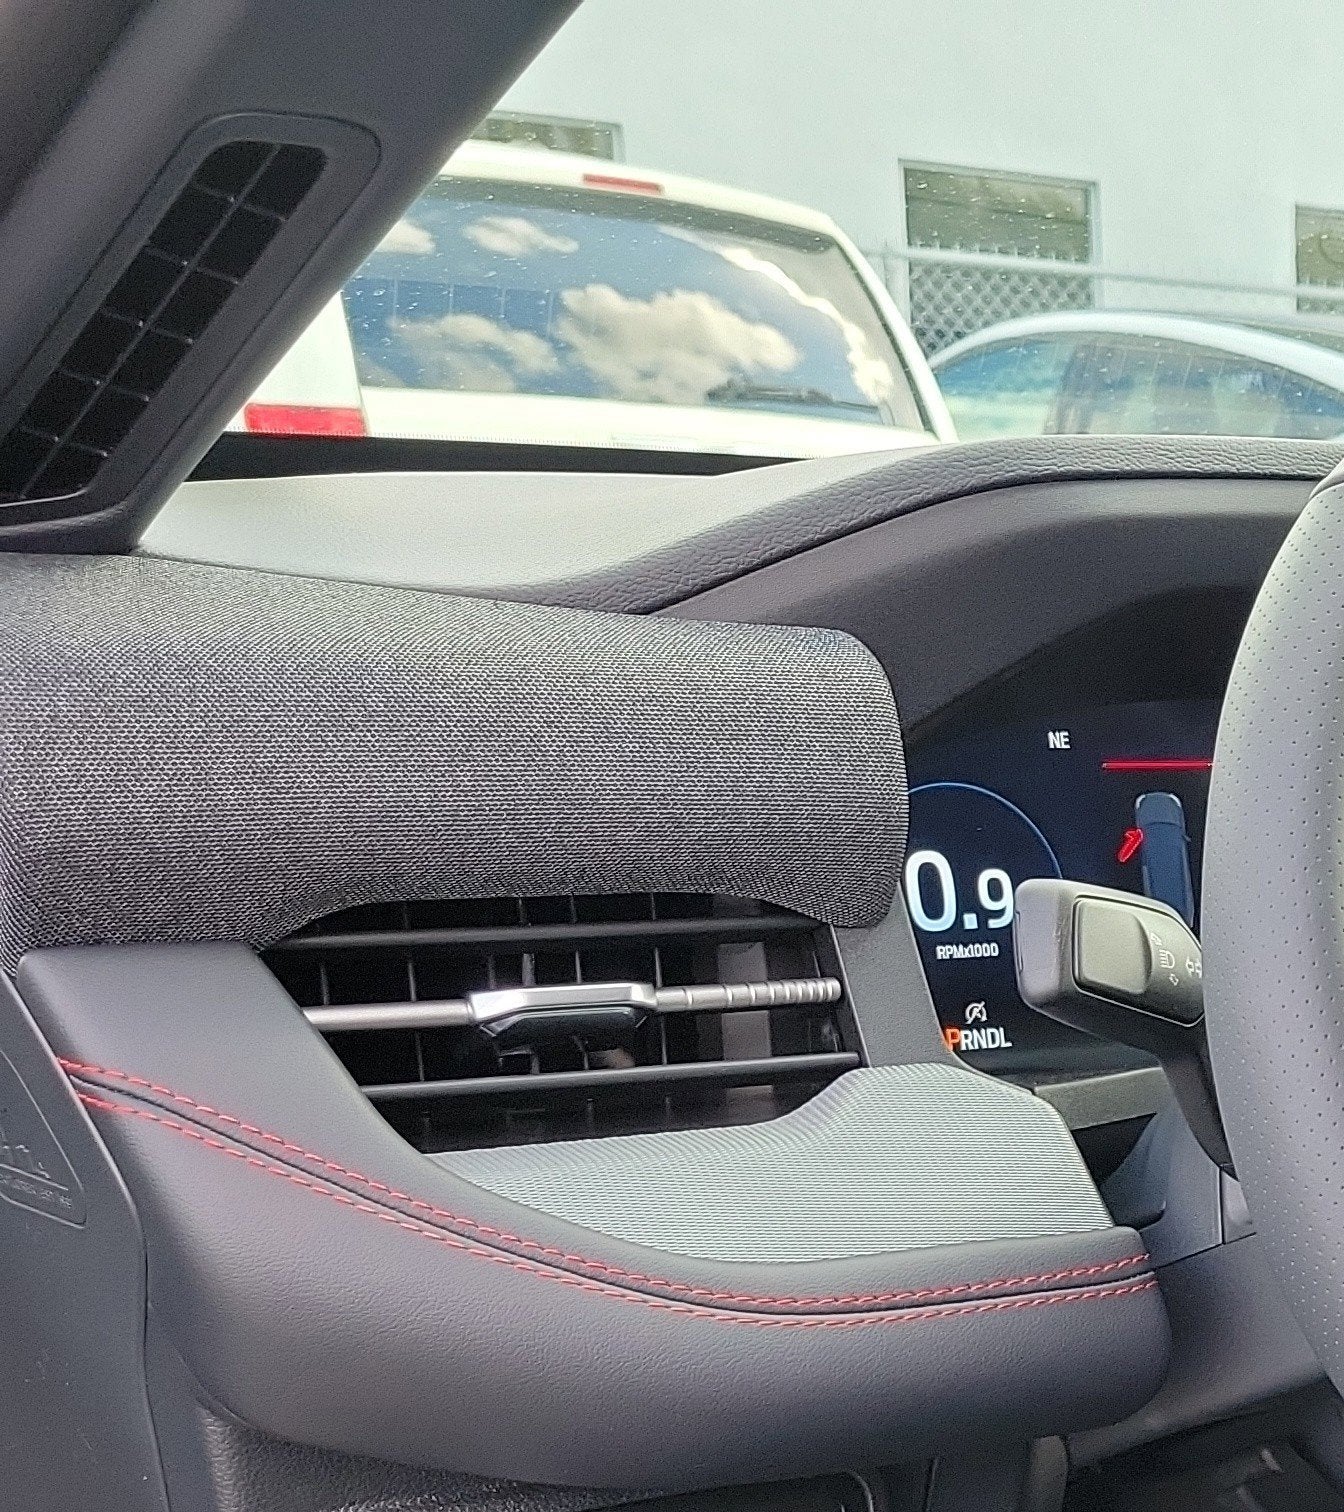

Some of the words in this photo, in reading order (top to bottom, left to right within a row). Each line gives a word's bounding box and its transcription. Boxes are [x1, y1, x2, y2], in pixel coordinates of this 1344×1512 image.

[1048, 731, 1071, 749] NE
[905, 850, 1014, 931] 0.9
[936, 943, 1000, 960] RPMx1000
